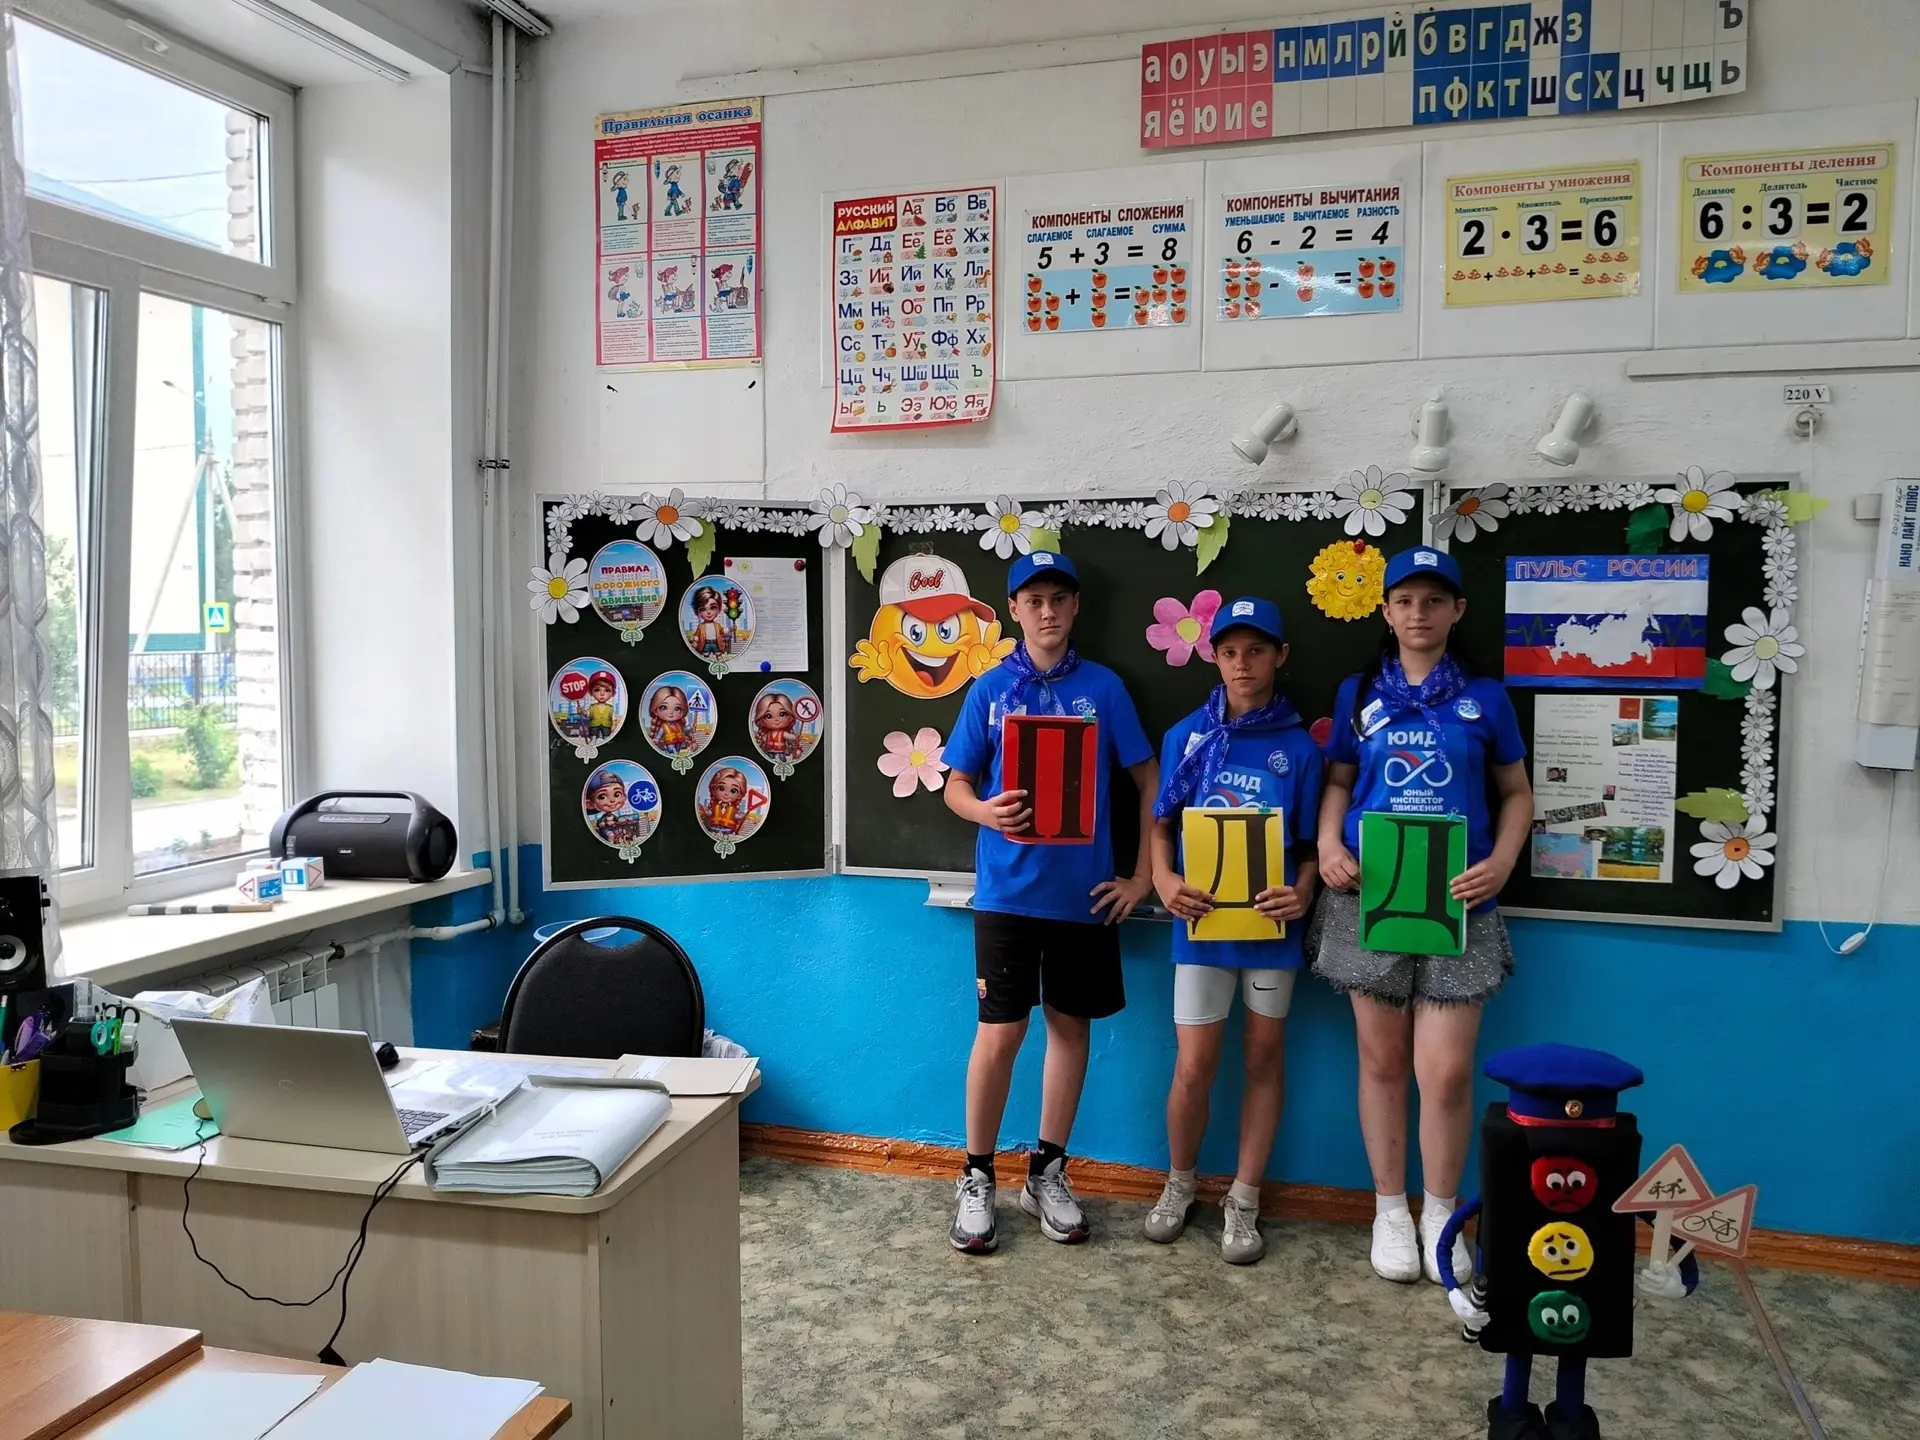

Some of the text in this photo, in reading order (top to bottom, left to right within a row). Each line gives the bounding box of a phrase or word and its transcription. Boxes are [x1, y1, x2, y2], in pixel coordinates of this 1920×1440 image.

[1145, 54, 1160, 84] а
[1170, 53, 1187, 80] о
[1198, 48, 1214, 86] у
[1221, 45, 1244, 74] ы
[1252, 43, 1268, 71] э
[1279, 41, 1295, 68] н
[1304, 37, 1326, 66] м
[1333, 35, 1351, 64] л
[1361, 31, 1380, 68] р
[1388, 13, 1407, 58] й
[1419, 15, 1438, 55] б
[1450, 25, 1466, 53] в
[1479, 22, 1493, 50] г
[1504, 19, 1526, 53] д
[1533, 16, 1560, 45] ж
[1566, 12, 1582, 43] з
[1144, 110, 1160, 138] я
[1169, 98, 1185, 137] ё
[1194, 105, 1217, 134] ю
[1225, 103, 1242, 131] и
[1251, 100, 1268, 128] е
[1419, 85, 1437, 113] п
[1444, 76, 1469, 118] ф
[1477, 81, 1494, 109] к
[1504, 78, 1521, 106] т
[1531, 76, 1556, 105] ш
[1565, 71, 1583, 101] с
[1594, 70, 1612, 99] х
[1624, 68, 1644, 102] ц
[1656, 66, 1674, 93] ч
[1684, 61, 1712, 93] щ
[602, 106, 752, 134] Правильная осанка
[1700, 155, 1876, 178] Компоненты деления
[1454, 173, 1630, 198] Компоненты умножения
[1692, 178, 1878, 197] Делимое Делитель Частное
[838, 200, 895, 219] РУССКИЙ
[902, 194, 987, 216] Аа Бб Вв
[1226, 187, 1400, 213] КОМПОНЕНТЫ ВЫЧИТАНИЯ
[1454, 194, 1633, 215] Множитель Множитель Произведение
[836, 216, 896, 232] АЛФАВИТ
[1032, 205, 1184, 229] КОМПОНЕНТЫ СЛОЖЕНИЯ
[1224, 205, 1400, 227] УМЕНЬШАЕМОЕ ВЫЧИТАЕМОЕ РАЗНОСТЬ
[1700, 201, 1724, 240] 6
[1768, 197, 1793, 236] 3
[1842, 192, 1868, 232] 2
[842, 227, 990, 253] Гг Дд Ее Ёё Жж
[1027, 222, 1186, 243] СЛАГАЕМОЕ СЛАГАЕМОЕ СУММА
[1237, 230, 1253, 255] 6
[1299, 225, 1317, 250] 2
[1371, 221, 1390, 245] 4
[1462, 219, 1485, 256] 2
[1526, 214, 1549, 251] 3
[1594, 209, 1617, 247] 6
[1037, 246, 1053, 269] 5
[1094, 242, 1110, 265] 3
[1161, 237, 1178, 261] 8
[839, 261, 984, 286] Зз Ии Йй Кк Лл
[838, 295, 985, 319] Мм Нн Оо Пп Рр
[840, 329, 986, 352] Сс Тт Уу Фф Хх
[841, 369, 863, 386] Цц
[872, 367, 891, 382] Чч
[901, 366, 927, 381] Шш
[931, 364, 959, 384] Щщ
[901, 397, 922, 412] Ээ
[930, 396, 957, 411] Юю
[964, 395, 984, 409] Яя
[1786, 388, 1826, 400] 220 V
[1899, 485, 1919, 568] НАНО ЛАЙТ ПЛЮС
[601, 565, 650, 574] ПРАВИЛА
[1515, 559, 1697, 579] ПУЛЬС РОССИИ
[594, 580, 660, 590] ДОРОЖНОГО
[910, 570, 943, 591] Cool
[600, 595, 657, 604] ДВИЖЕНИЯ
[562, 680, 586, 693] STOP
[1387, 731, 1436, 747] ЮИД
[1007, 719, 1096, 838] П
[1214, 771, 1261, 793] ЮИД
[1403, 788, 1434, 796] ЮНЫЙ
[1192, 814, 1281, 935] Д
[1364, 817, 1463, 949] Д
